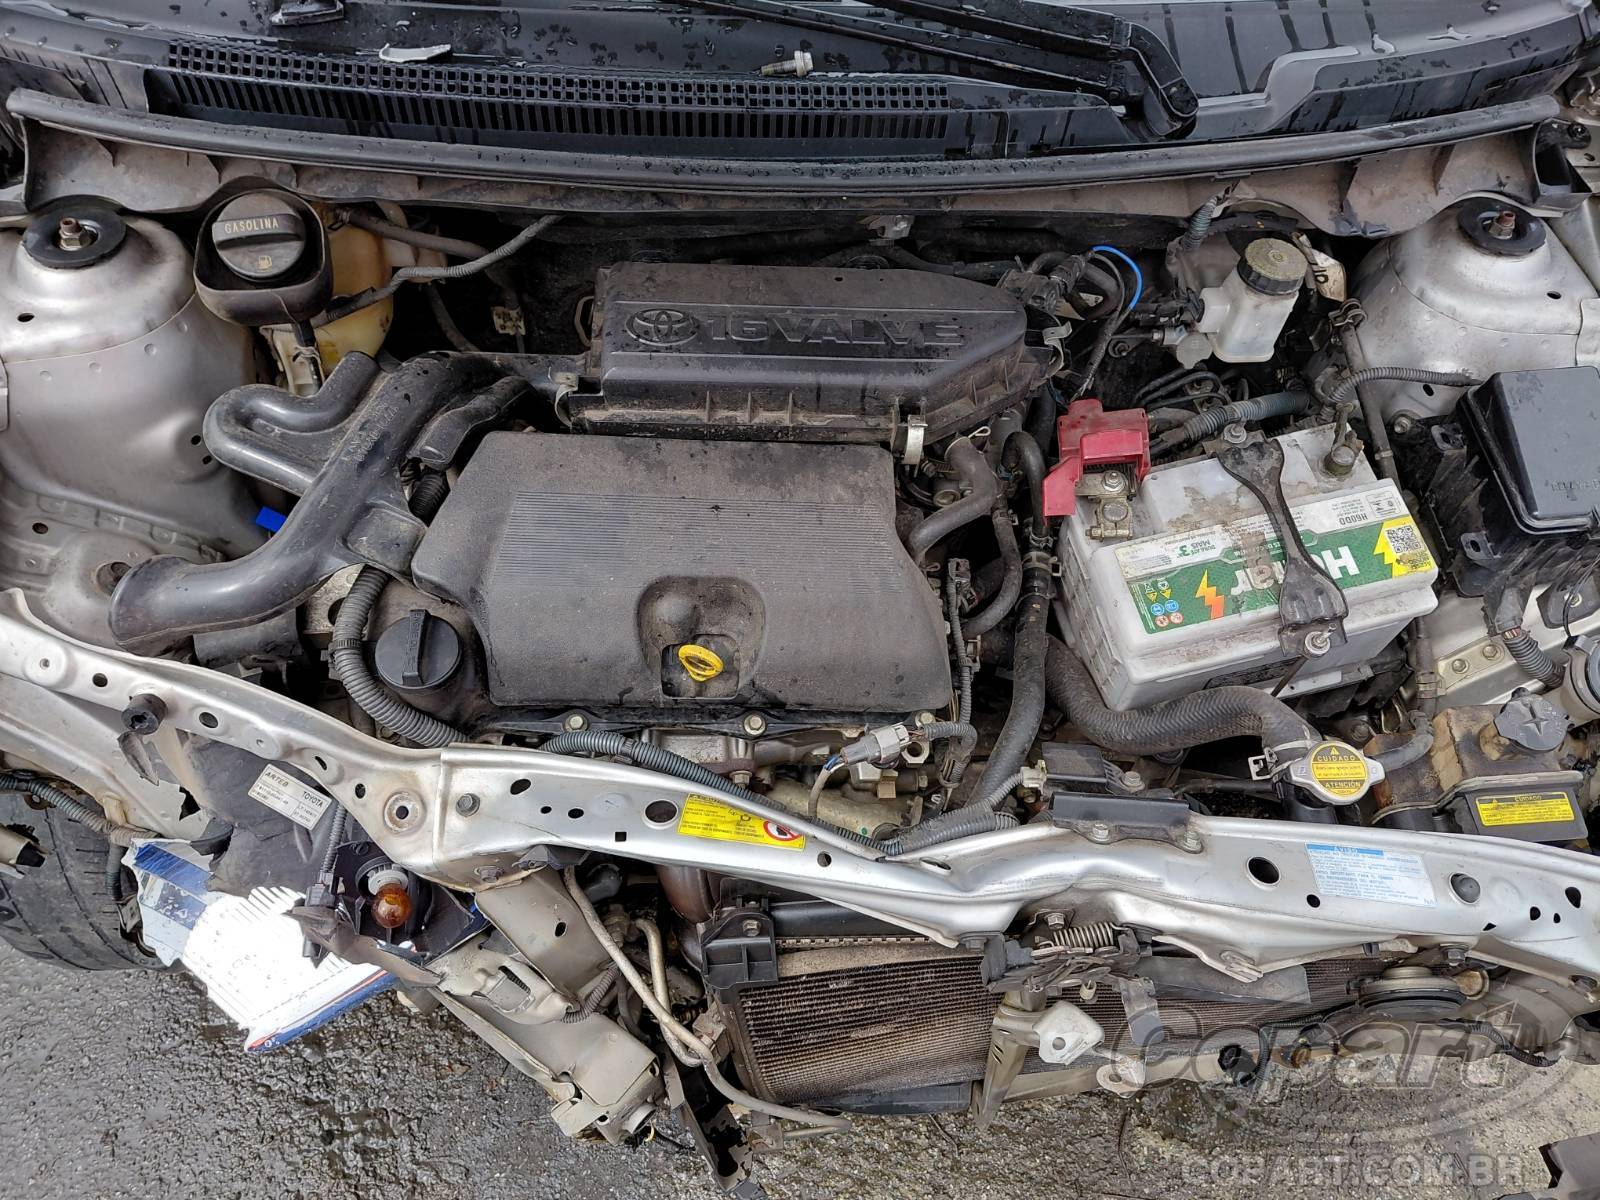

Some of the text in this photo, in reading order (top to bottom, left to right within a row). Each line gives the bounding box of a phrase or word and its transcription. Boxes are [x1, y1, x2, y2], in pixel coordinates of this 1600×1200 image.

[224, 215, 279, 234] GASOLINA
[1317, 754, 1356, 762] CUIDADO
[303, 790, 324, 808] TOYOTA
